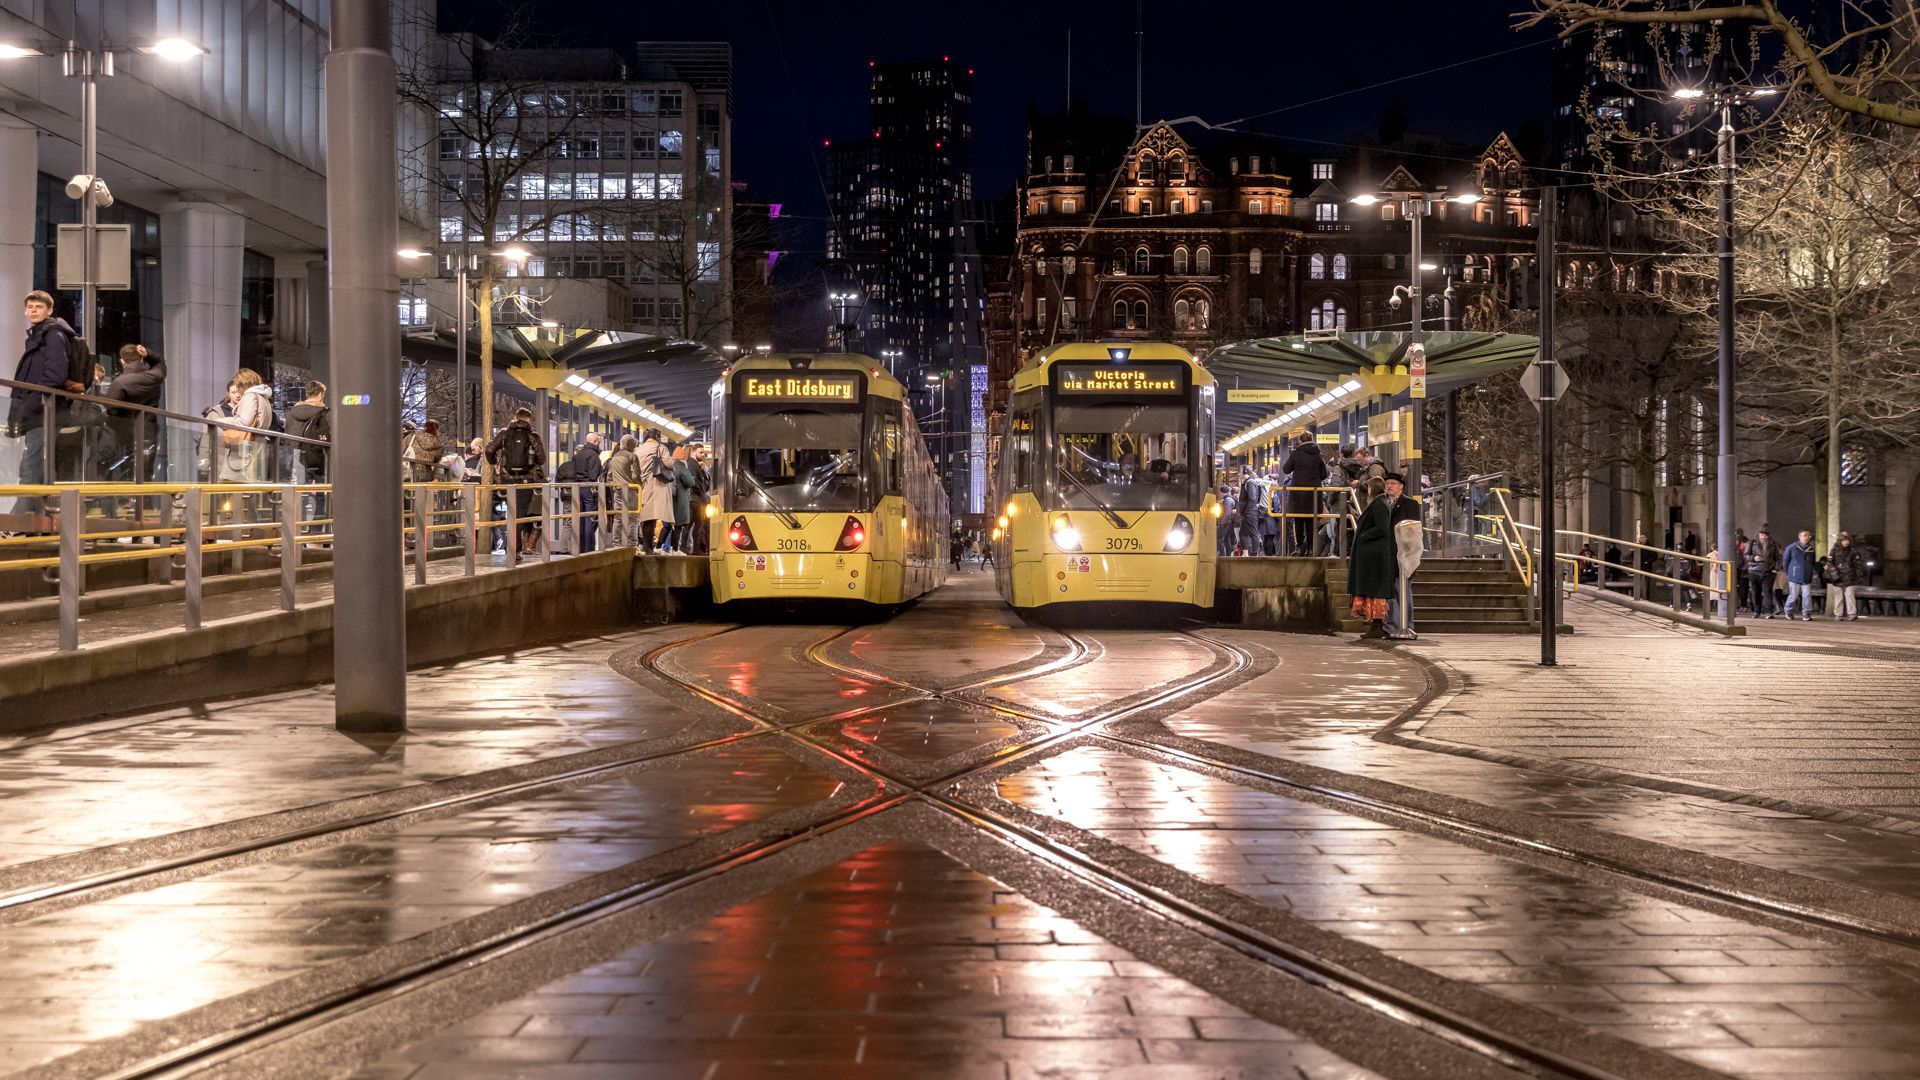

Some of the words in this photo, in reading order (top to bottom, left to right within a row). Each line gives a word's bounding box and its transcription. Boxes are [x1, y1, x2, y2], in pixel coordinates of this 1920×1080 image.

[1095, 371, 1145, 380] Victoria
[748, 379, 781, 396] East
[787, 379, 851, 399] Didsbury
[1064, 380, 1082, 389] via
[1087, 380, 1129, 389] Market
[1134, 380, 1176, 389] Street
